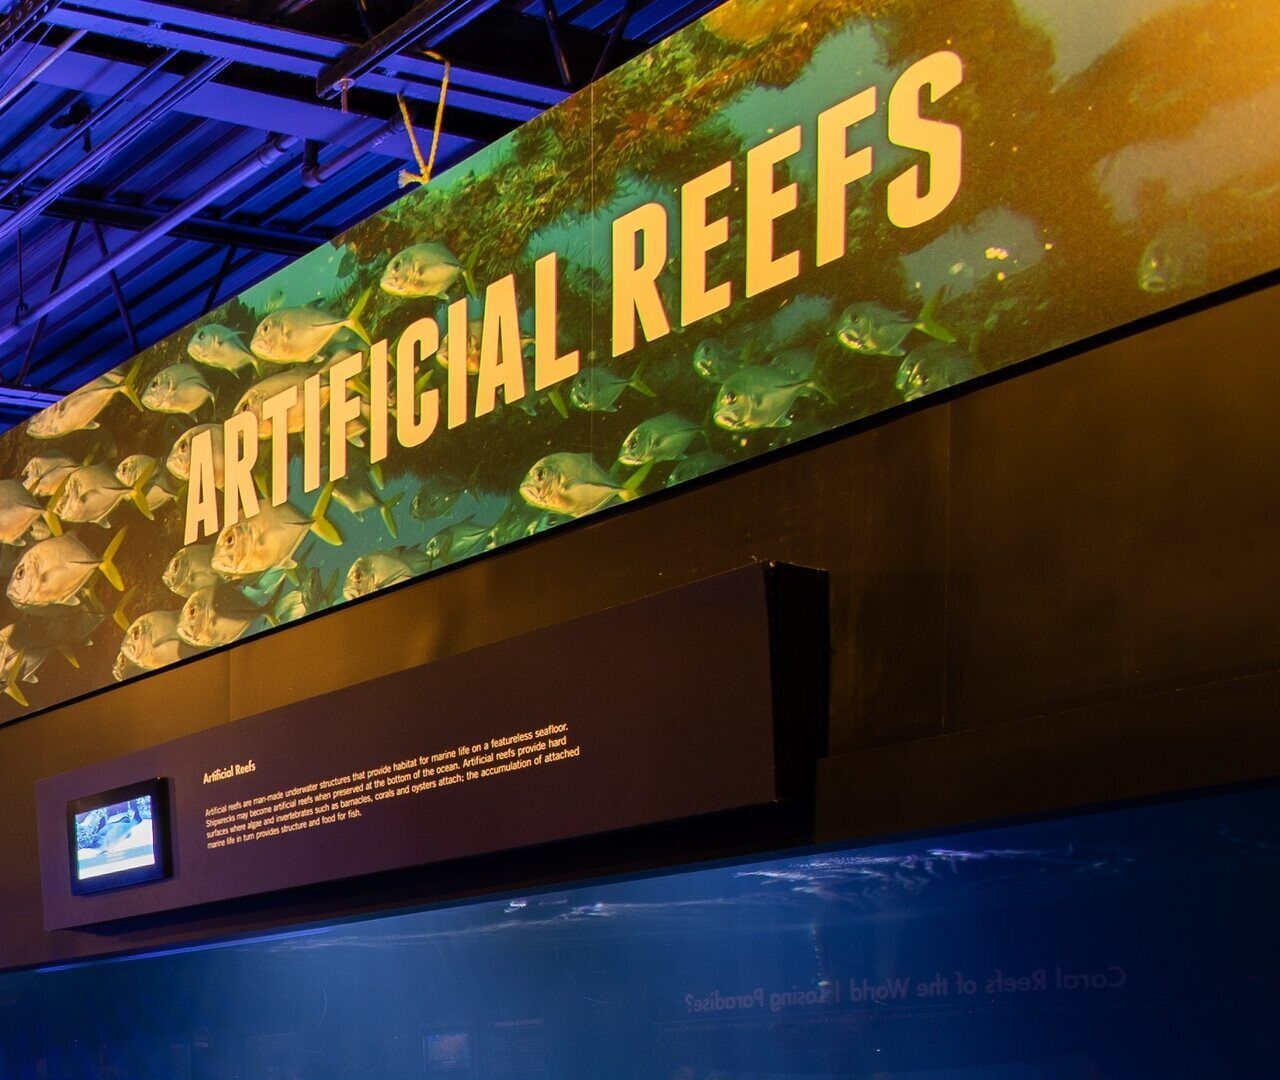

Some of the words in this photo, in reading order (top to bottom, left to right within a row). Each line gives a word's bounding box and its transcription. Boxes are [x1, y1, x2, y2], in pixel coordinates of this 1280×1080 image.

[183, 254, 579, 547] ARTIFICIAL
[612, 50, 963, 357] REEFS
[203, 766, 234, 784] Artificial
[234, 761, 256, 777] Reefs
